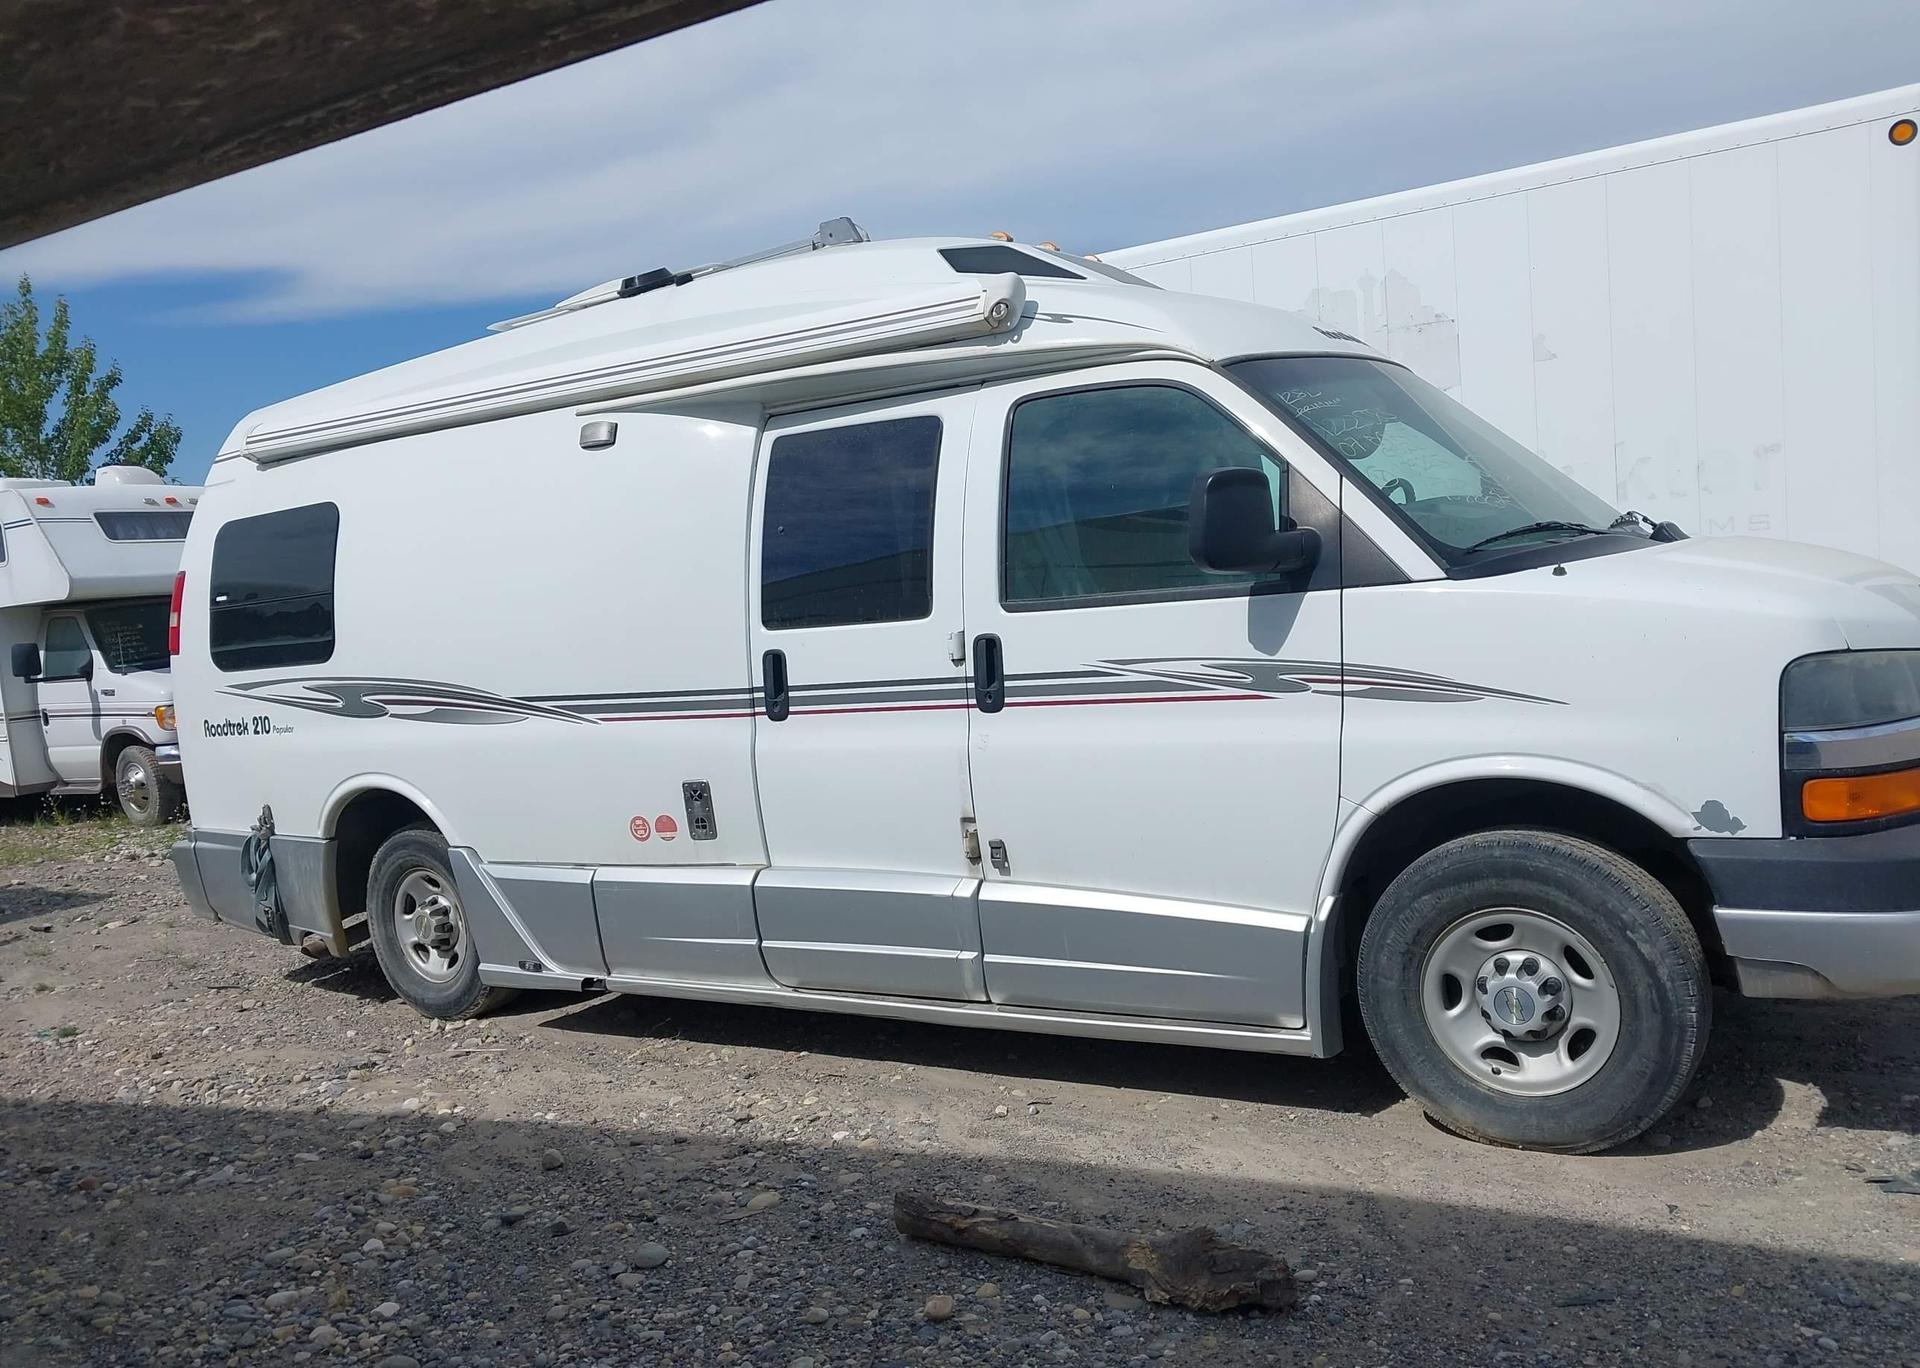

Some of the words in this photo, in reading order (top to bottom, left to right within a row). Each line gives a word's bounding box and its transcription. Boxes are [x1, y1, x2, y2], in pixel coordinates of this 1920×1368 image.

[203, 717, 250, 738] Roadtrek
[252, 715, 271, 735] 210
[272, 724, 295, 736] Popular
